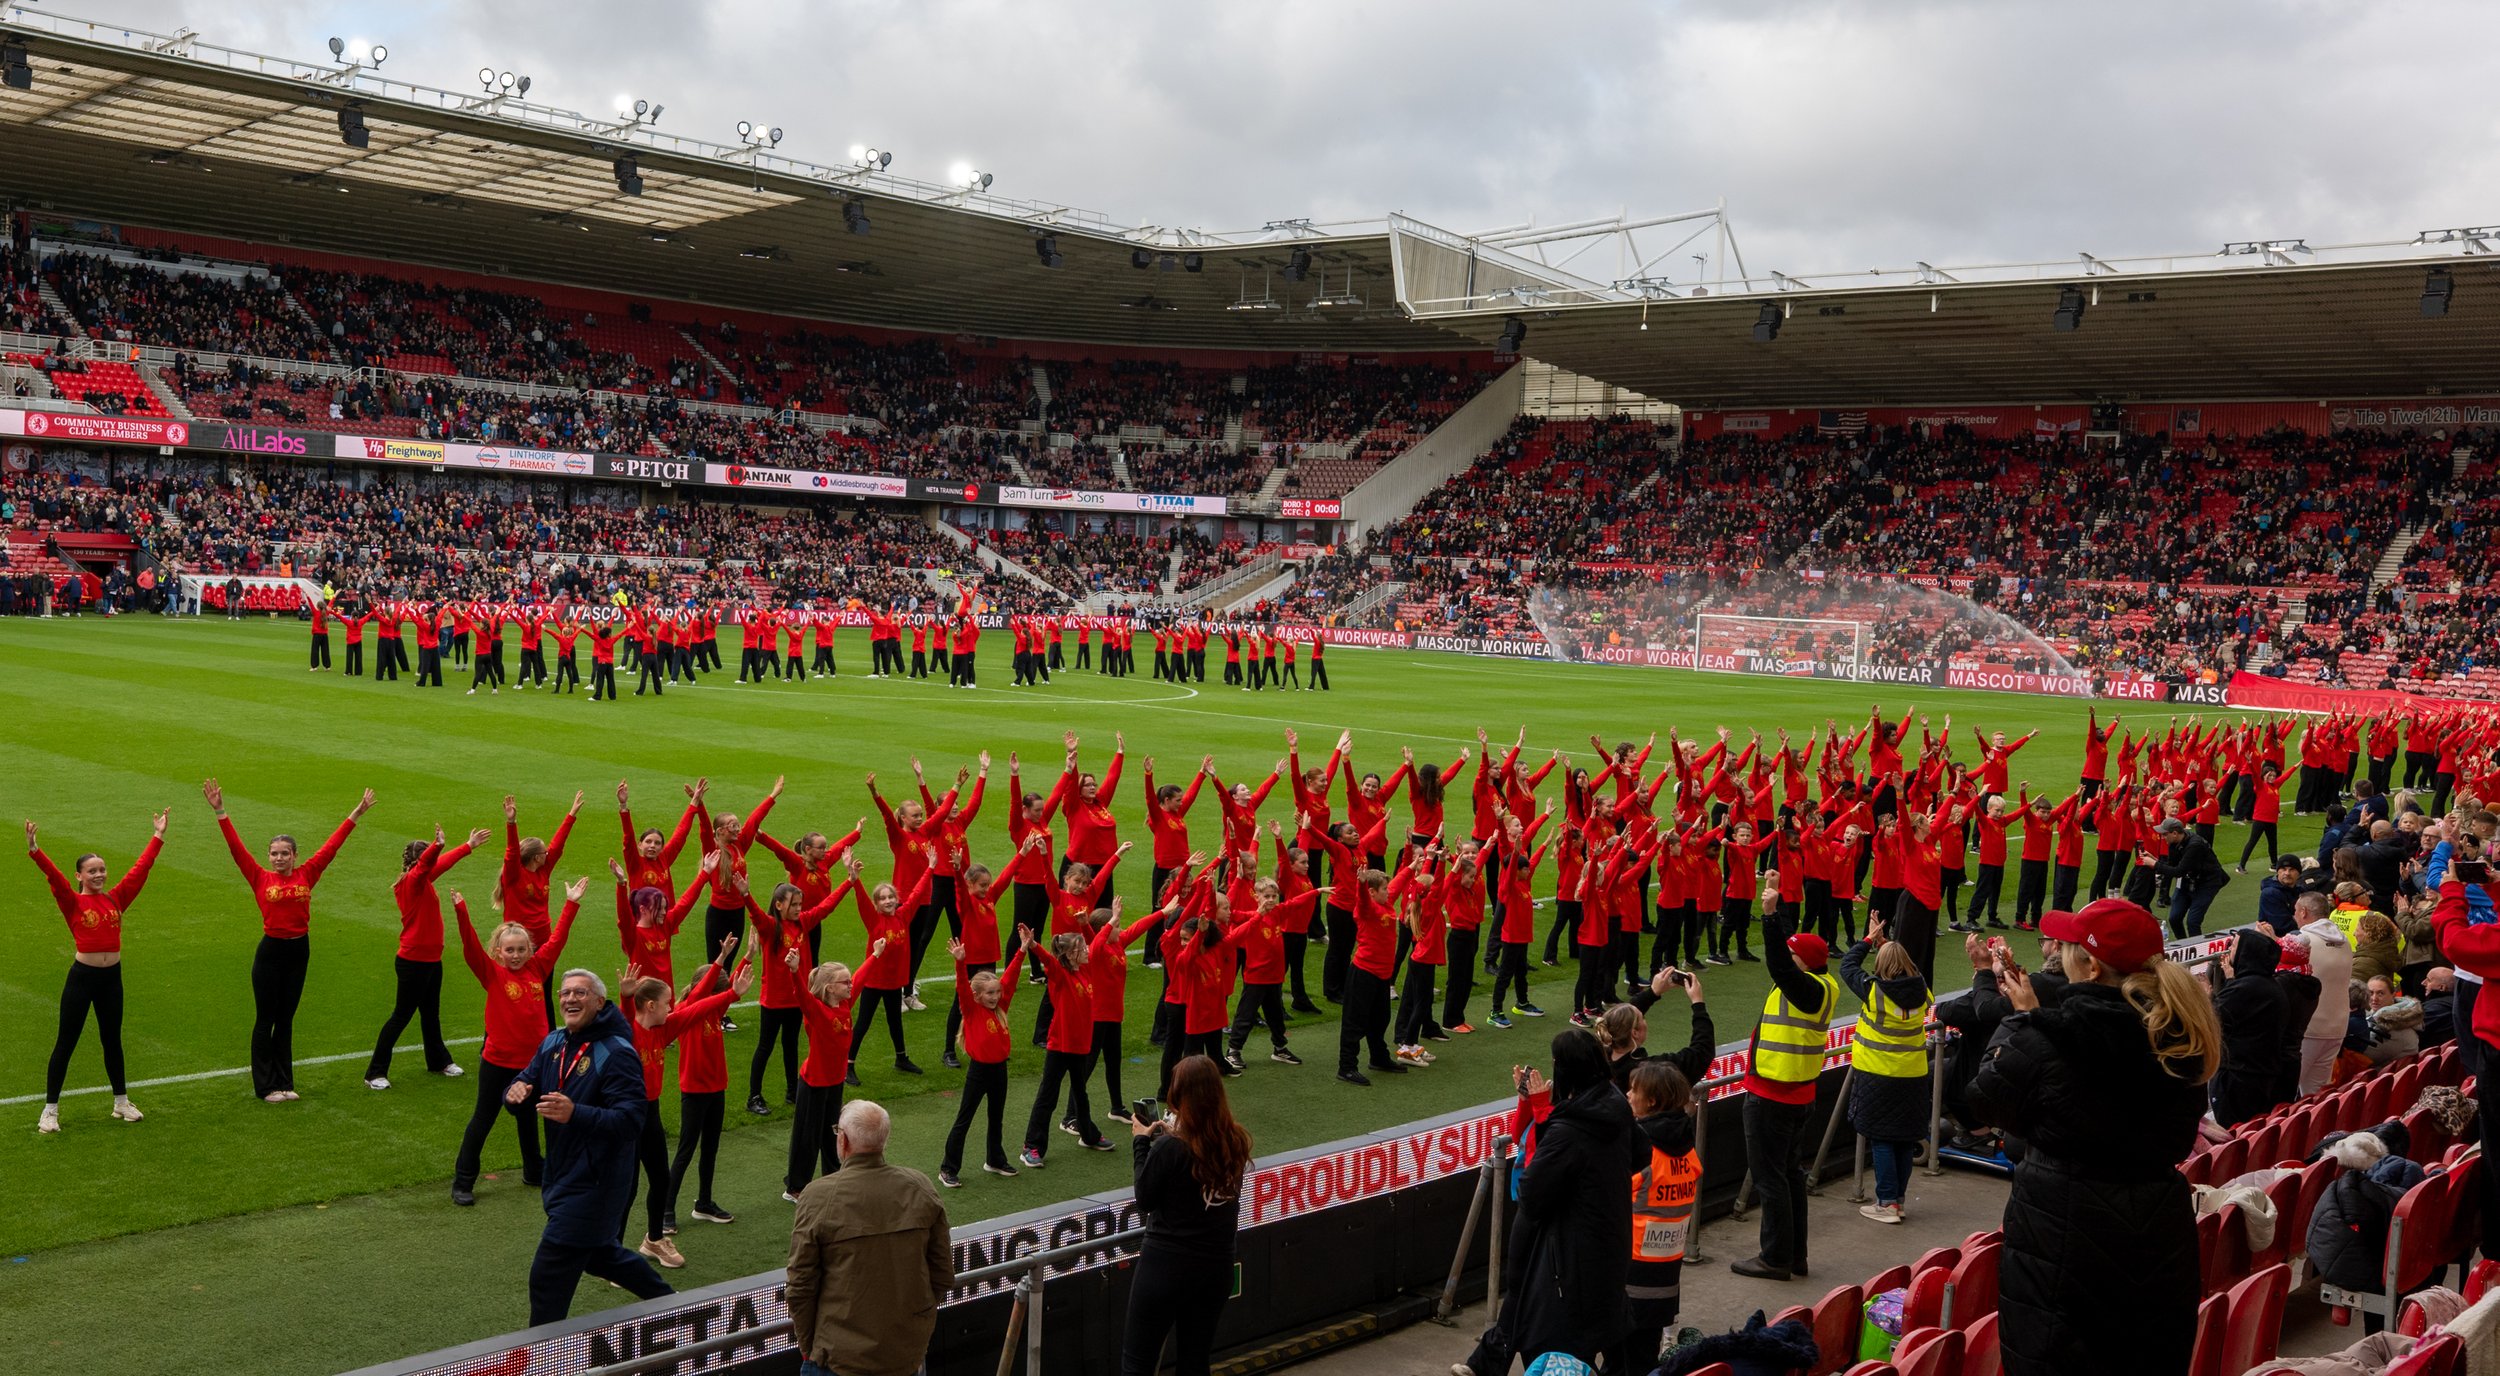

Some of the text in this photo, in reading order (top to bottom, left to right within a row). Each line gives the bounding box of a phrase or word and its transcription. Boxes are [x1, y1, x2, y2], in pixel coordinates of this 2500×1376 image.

[2354, 408, 2386, 424] The
[2463, 405, 2500, 423] Man
[54, 416, 162, 433] COMMUNITY BUSINESS
[101, 428, 148, 440] MEMBERS
[222, 427, 306, 454] AltLabs
[369, 440, 442, 459] Hp Freightways
[509, 450, 556, 461] LINTHORPE
[509, 460, 556, 470] PHARMACY
[610, 460, 689, 480] SG PETCH
[729, 467, 792, 484] MANTANK
[830, 479, 904, 494] Middlesbrough College
[1004, 487, 1026, 499] Sam
[1029, 488, 1053, 501] Turn
[1077, 491, 1104, 503] Sons
[1153, 496, 1195, 507] TITAN
[1314, 504, 1339, 514] 00:00
[1333, 629, 1405, 646] WORKWEAR
[1482, 639, 1561, 657] WORKWEAR
[1647, 650, 1735, 670] WORKWEAR
[1832, 661, 1932, 683] WORKWEAR
[1670, 1157, 1690, 1176] MFC
[1252, 1134, 1433, 1224] PROUDLY
